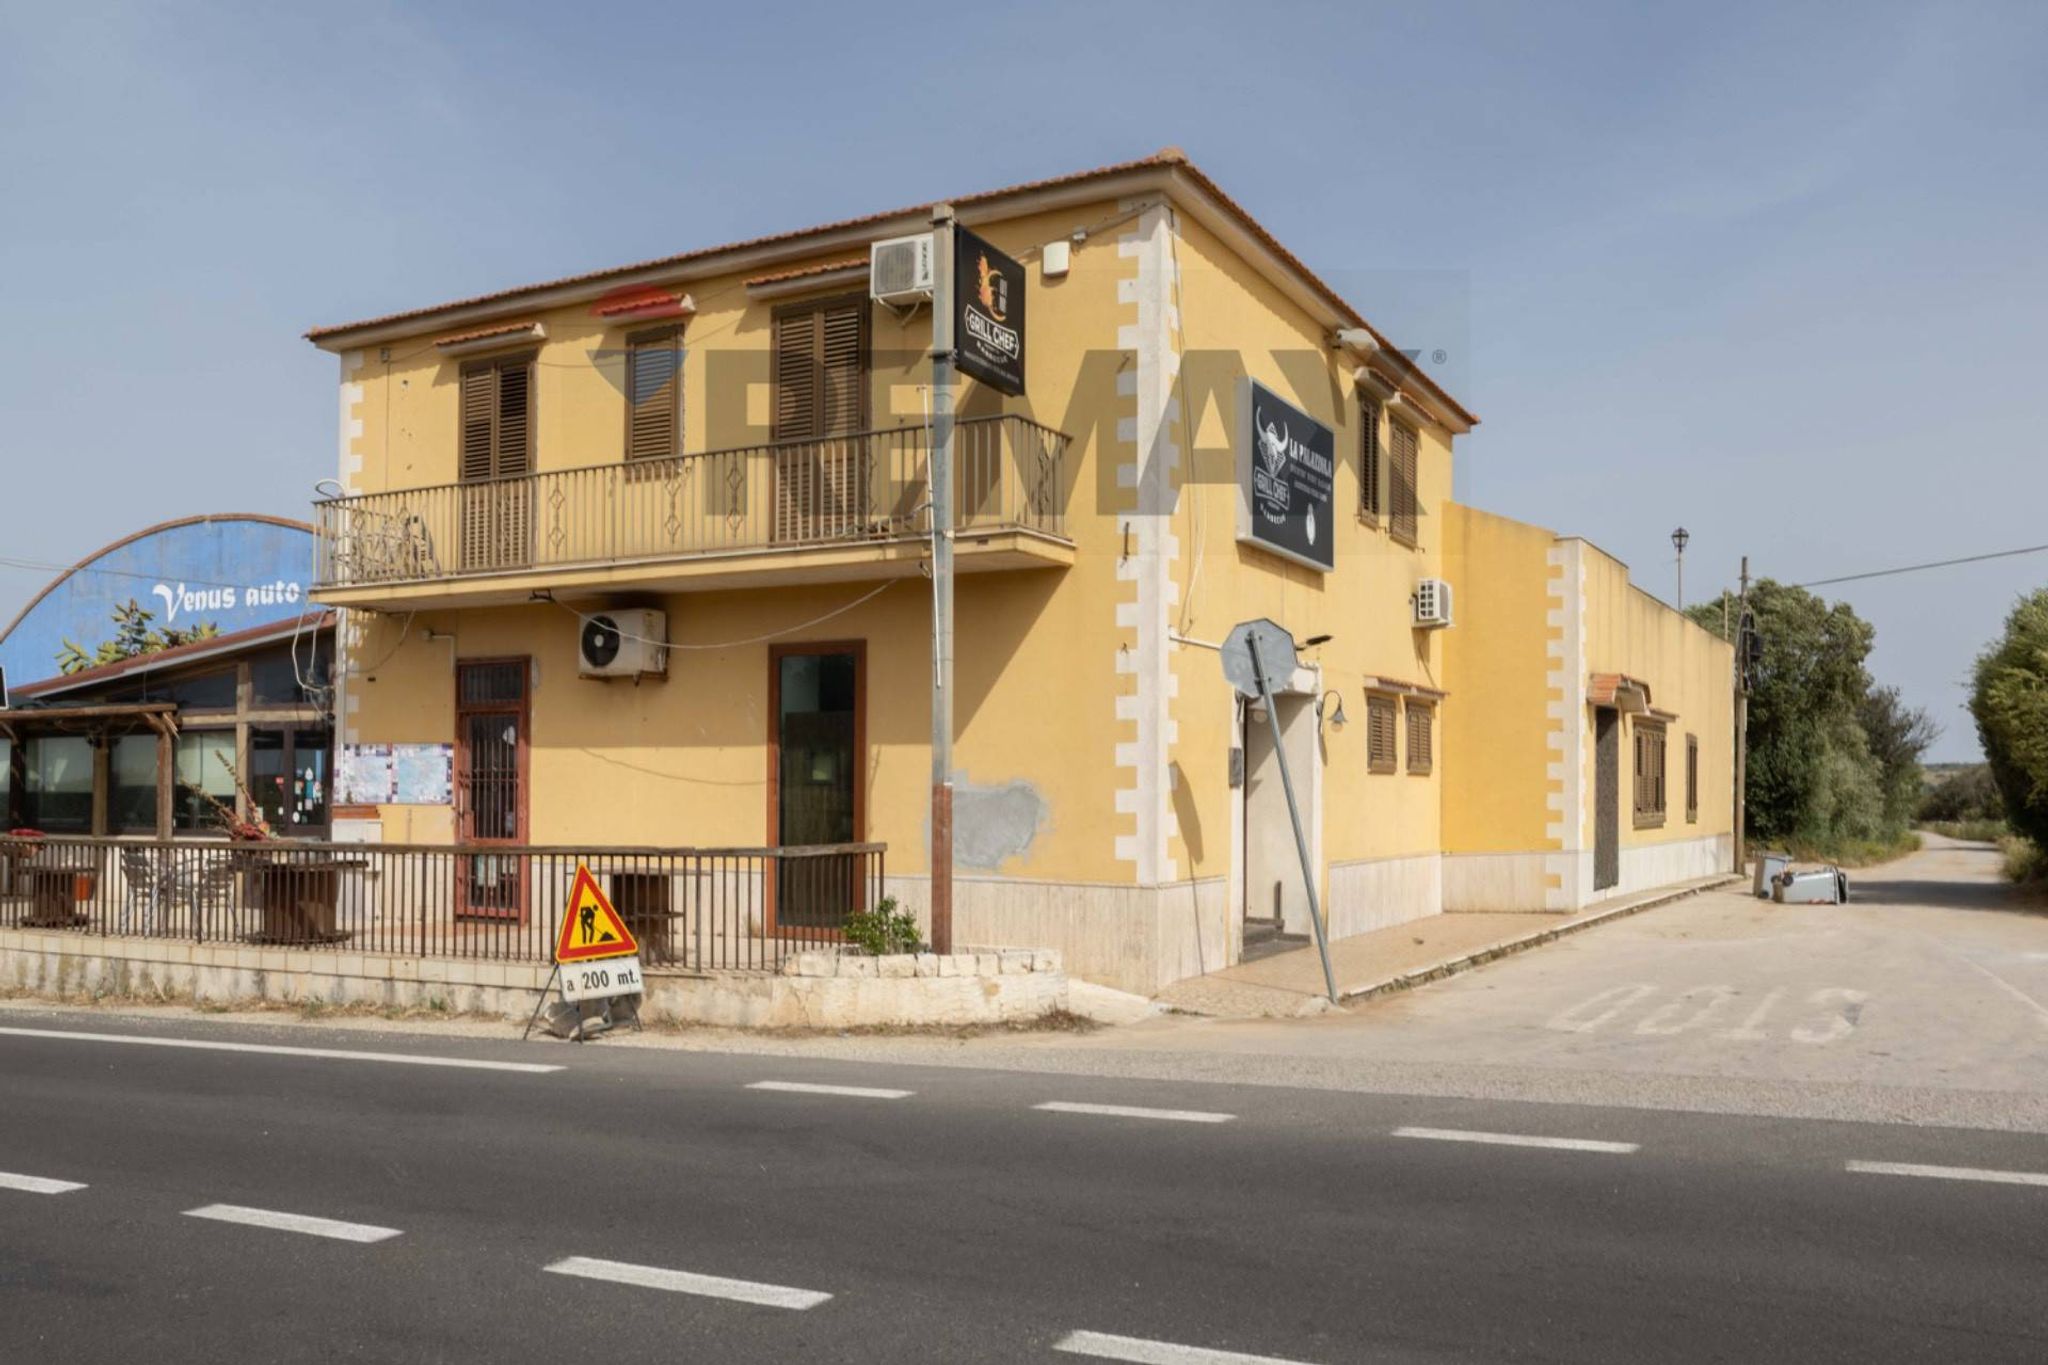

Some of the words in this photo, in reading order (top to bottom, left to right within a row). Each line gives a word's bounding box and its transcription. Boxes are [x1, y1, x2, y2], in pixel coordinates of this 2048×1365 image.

[969, 313, 992, 341] GRILL
[993, 326, 1014, 351] CHEF
[1289, 438, 1298, 460] LA
[152, 582, 236, 623] Venus
[246, 580, 300, 606] auto
[567, 980, 575, 992] a
[582, 969, 610, 990] 200
[617, 968, 639, 985] mt.
